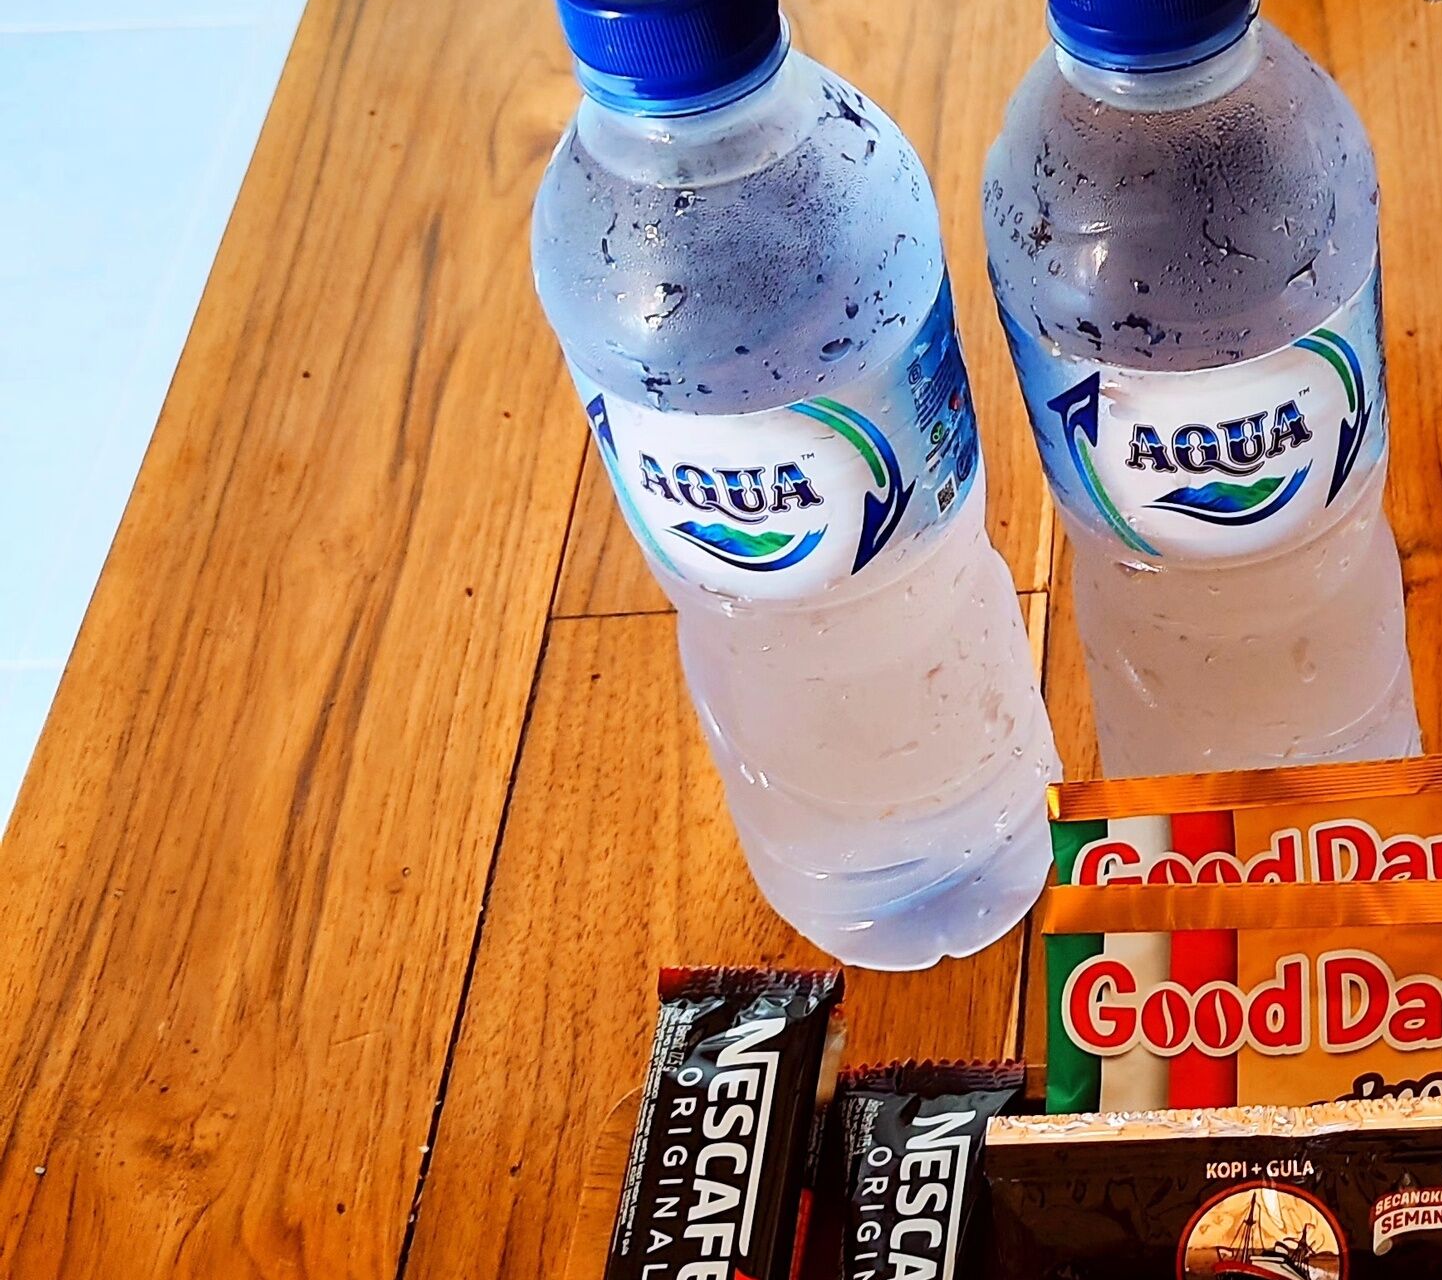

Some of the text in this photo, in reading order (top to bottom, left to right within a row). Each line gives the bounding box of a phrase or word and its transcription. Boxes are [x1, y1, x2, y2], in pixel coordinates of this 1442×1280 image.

[1126, 399, 1313, 475] AQUA
[638, 451, 823, 526] AQUA
[1063, 954, 1308, 1056] Good
[641, 1067, 704, 1280] ORIGINAL
[1206, 1159, 1315, 1179] KOPI + GULA
